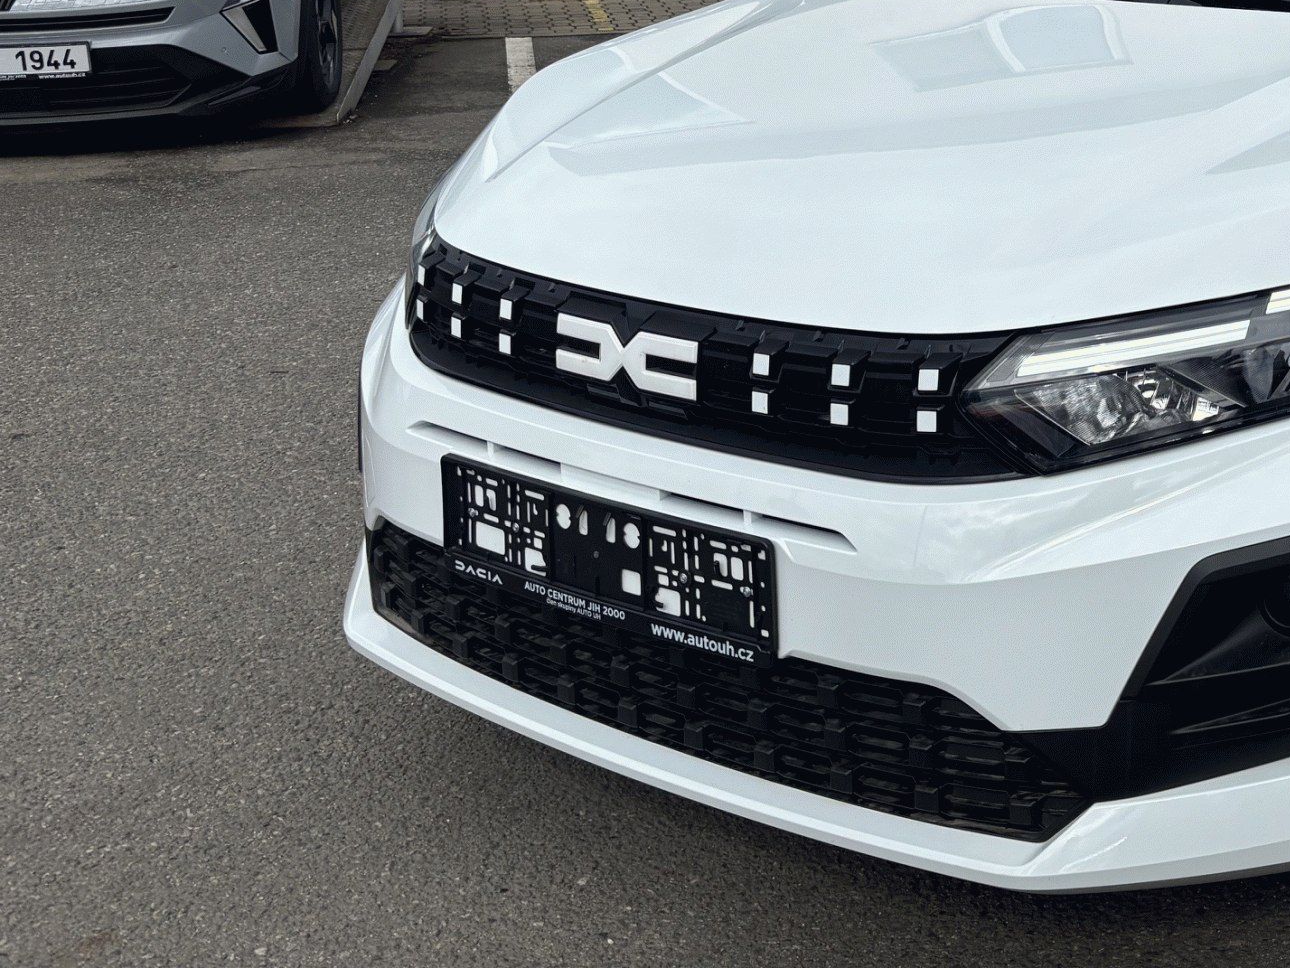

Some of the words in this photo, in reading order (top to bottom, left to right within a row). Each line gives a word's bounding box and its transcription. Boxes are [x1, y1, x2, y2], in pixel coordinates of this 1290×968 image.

[15, 48, 77, 71] 1944
[454, 559, 504, 585] DACIA
[524, 581, 547, 596] AUTO
[547, 589, 587, 609] CENTRUM
[587, 601, 601, 613] JIH
[602, 606, 626, 621] 2000
[577, 608, 592, 617] AUTO
[650, 623, 755, 662] www.autouh.cz
